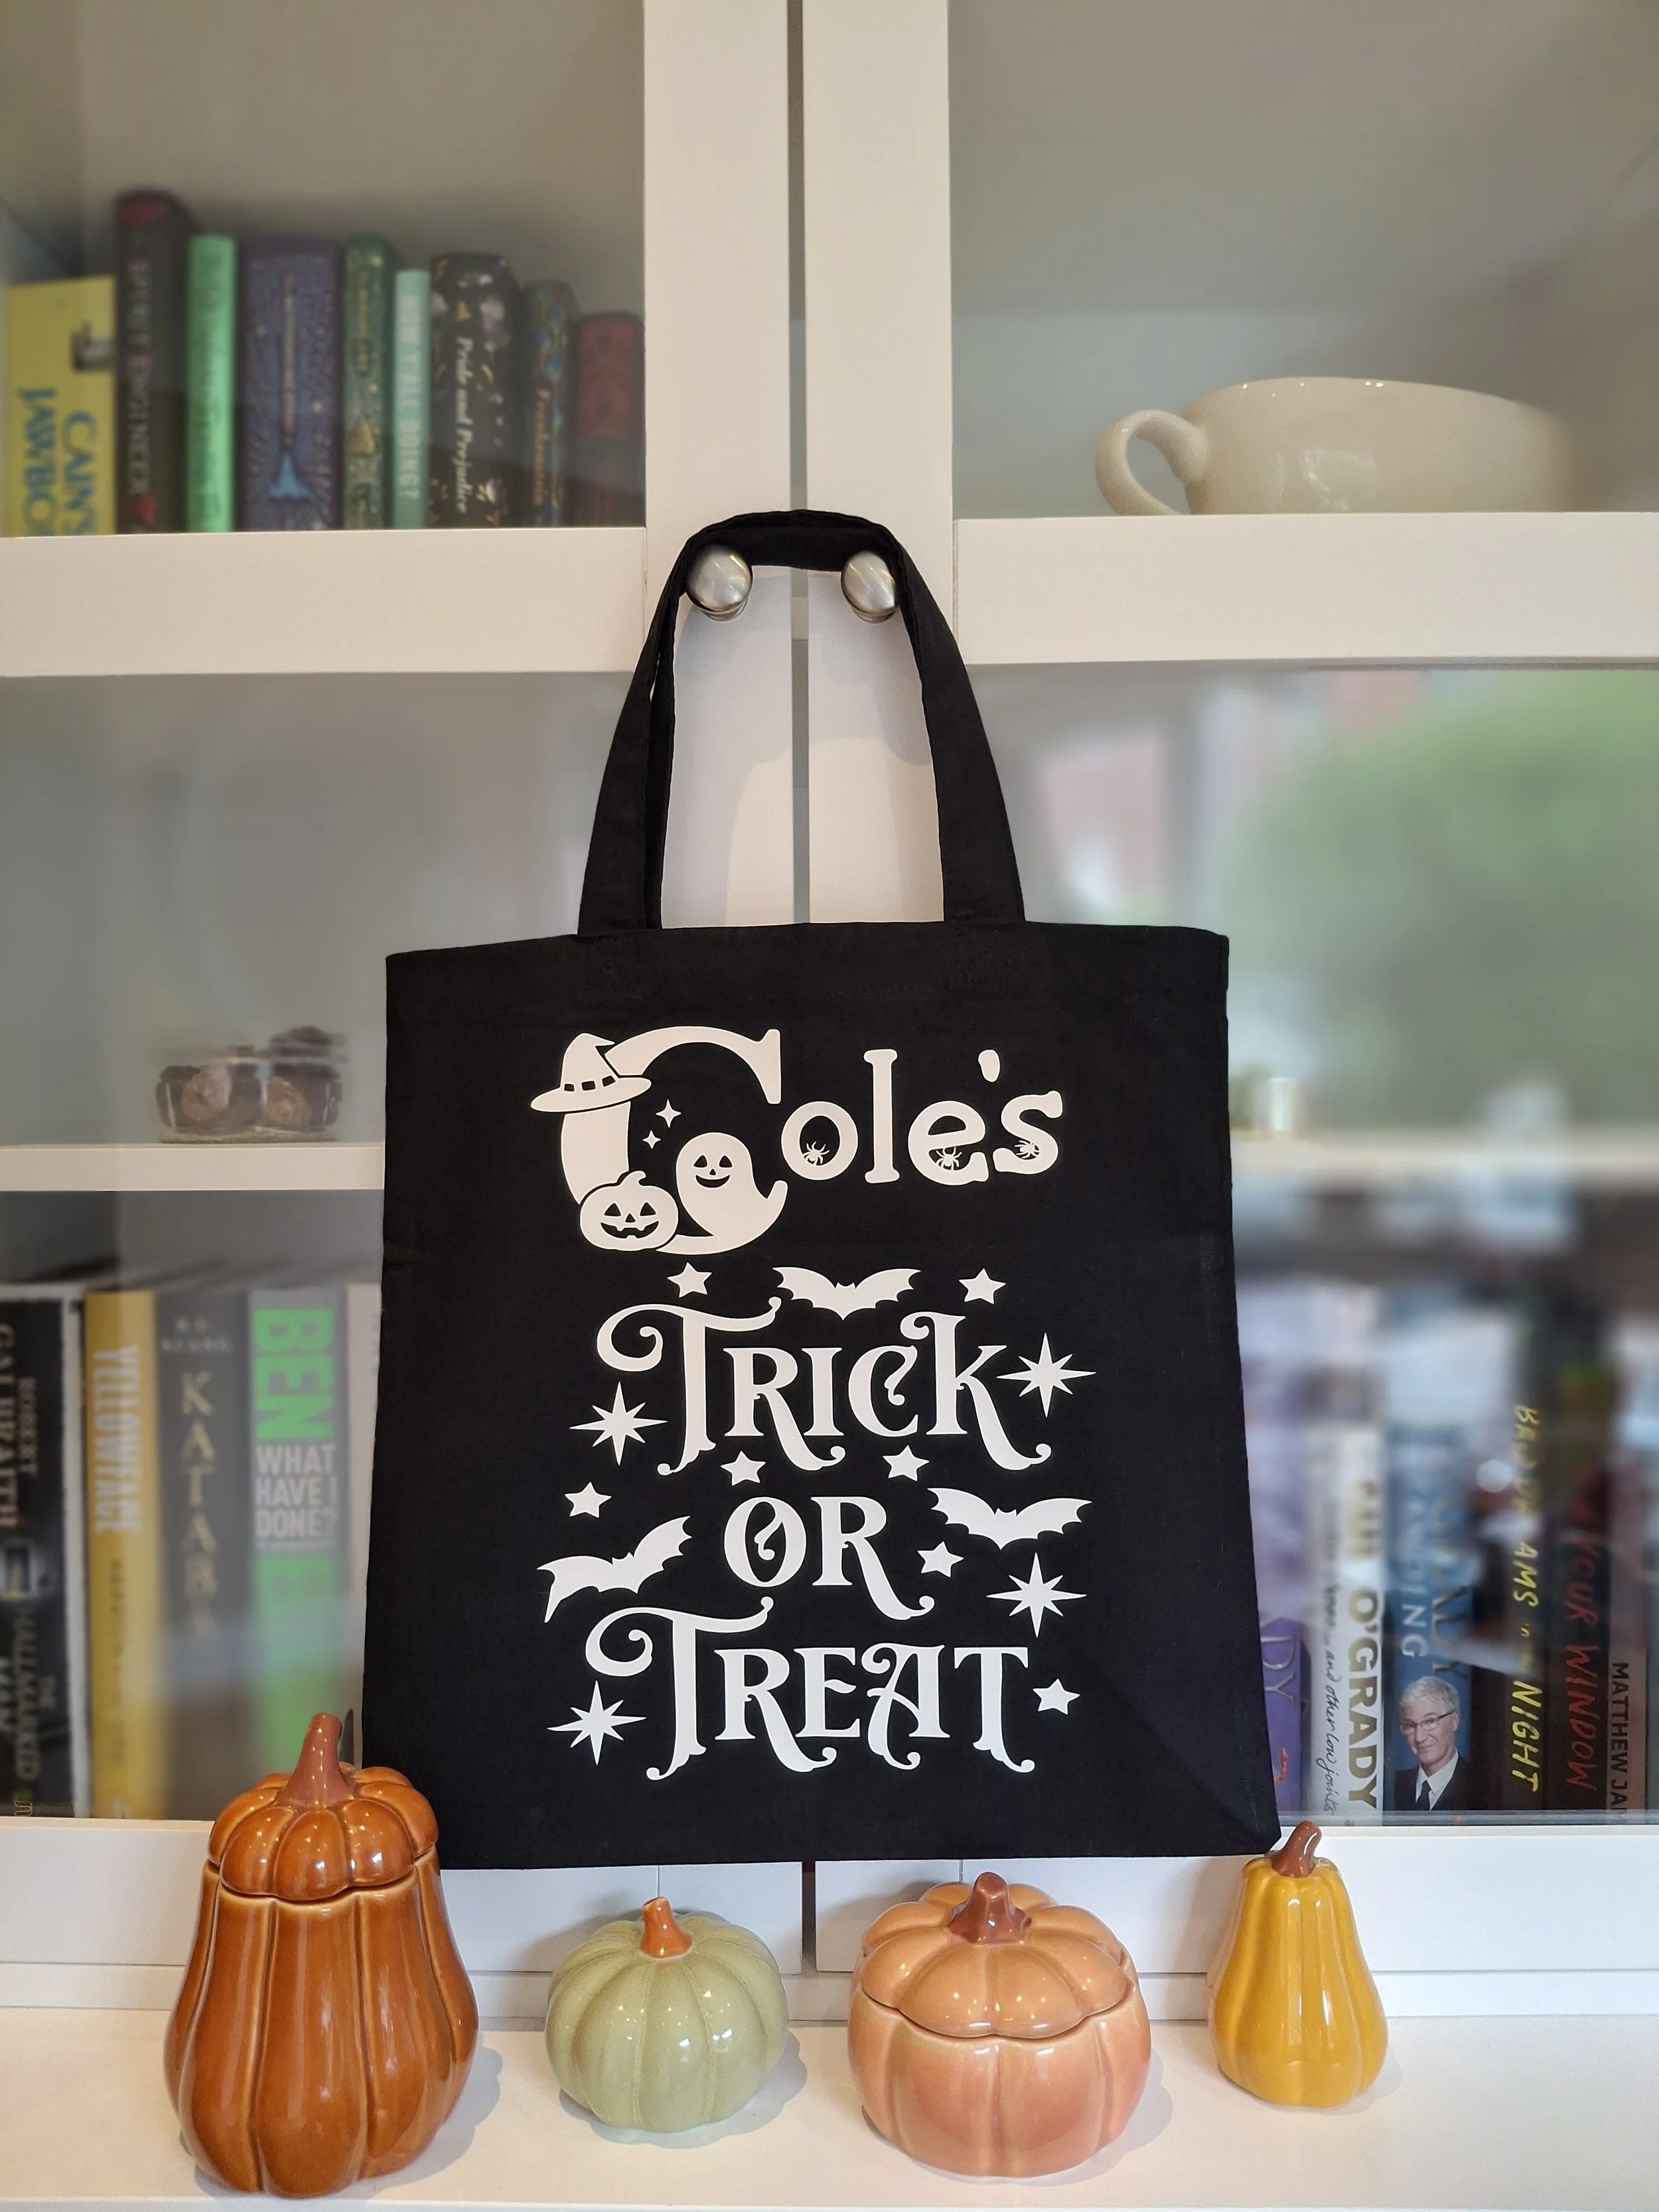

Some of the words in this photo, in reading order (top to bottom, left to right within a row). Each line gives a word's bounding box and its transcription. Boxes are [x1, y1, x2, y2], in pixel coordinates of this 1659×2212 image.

[455, 336, 474, 386] Pride
[456, 388, 474, 425] and
[399, 419, 422, 501] DOING?
[451, 428, 474, 514] Prejudice
[531, 1026, 1062, 1254] Cole's
[254, 1308, 334, 1440] BEN
[94, 1345, 141, 1534] YELLOWFACE
[256, 1443, 336, 1474] WHAT
[255, 1476, 322, 1507] HAVE
[329, 1475, 338, 1504] I
[255, 1508, 338, 1539] DONE?
[724, 1497, 935, 1619] OR
[1325, 1650, 1341, 1682] and
[1348, 1586, 1379, 1810] O'GRADY
[1325, 1684, 1340, 1733] other
[1326, 1733, 1340, 1765] low
[1511, 1680, 1542, 1792] NIGHT
[1565, 1644, 1600, 1791] WINDOW
[1611, 1662, 1630, 1773] MATTHEW
